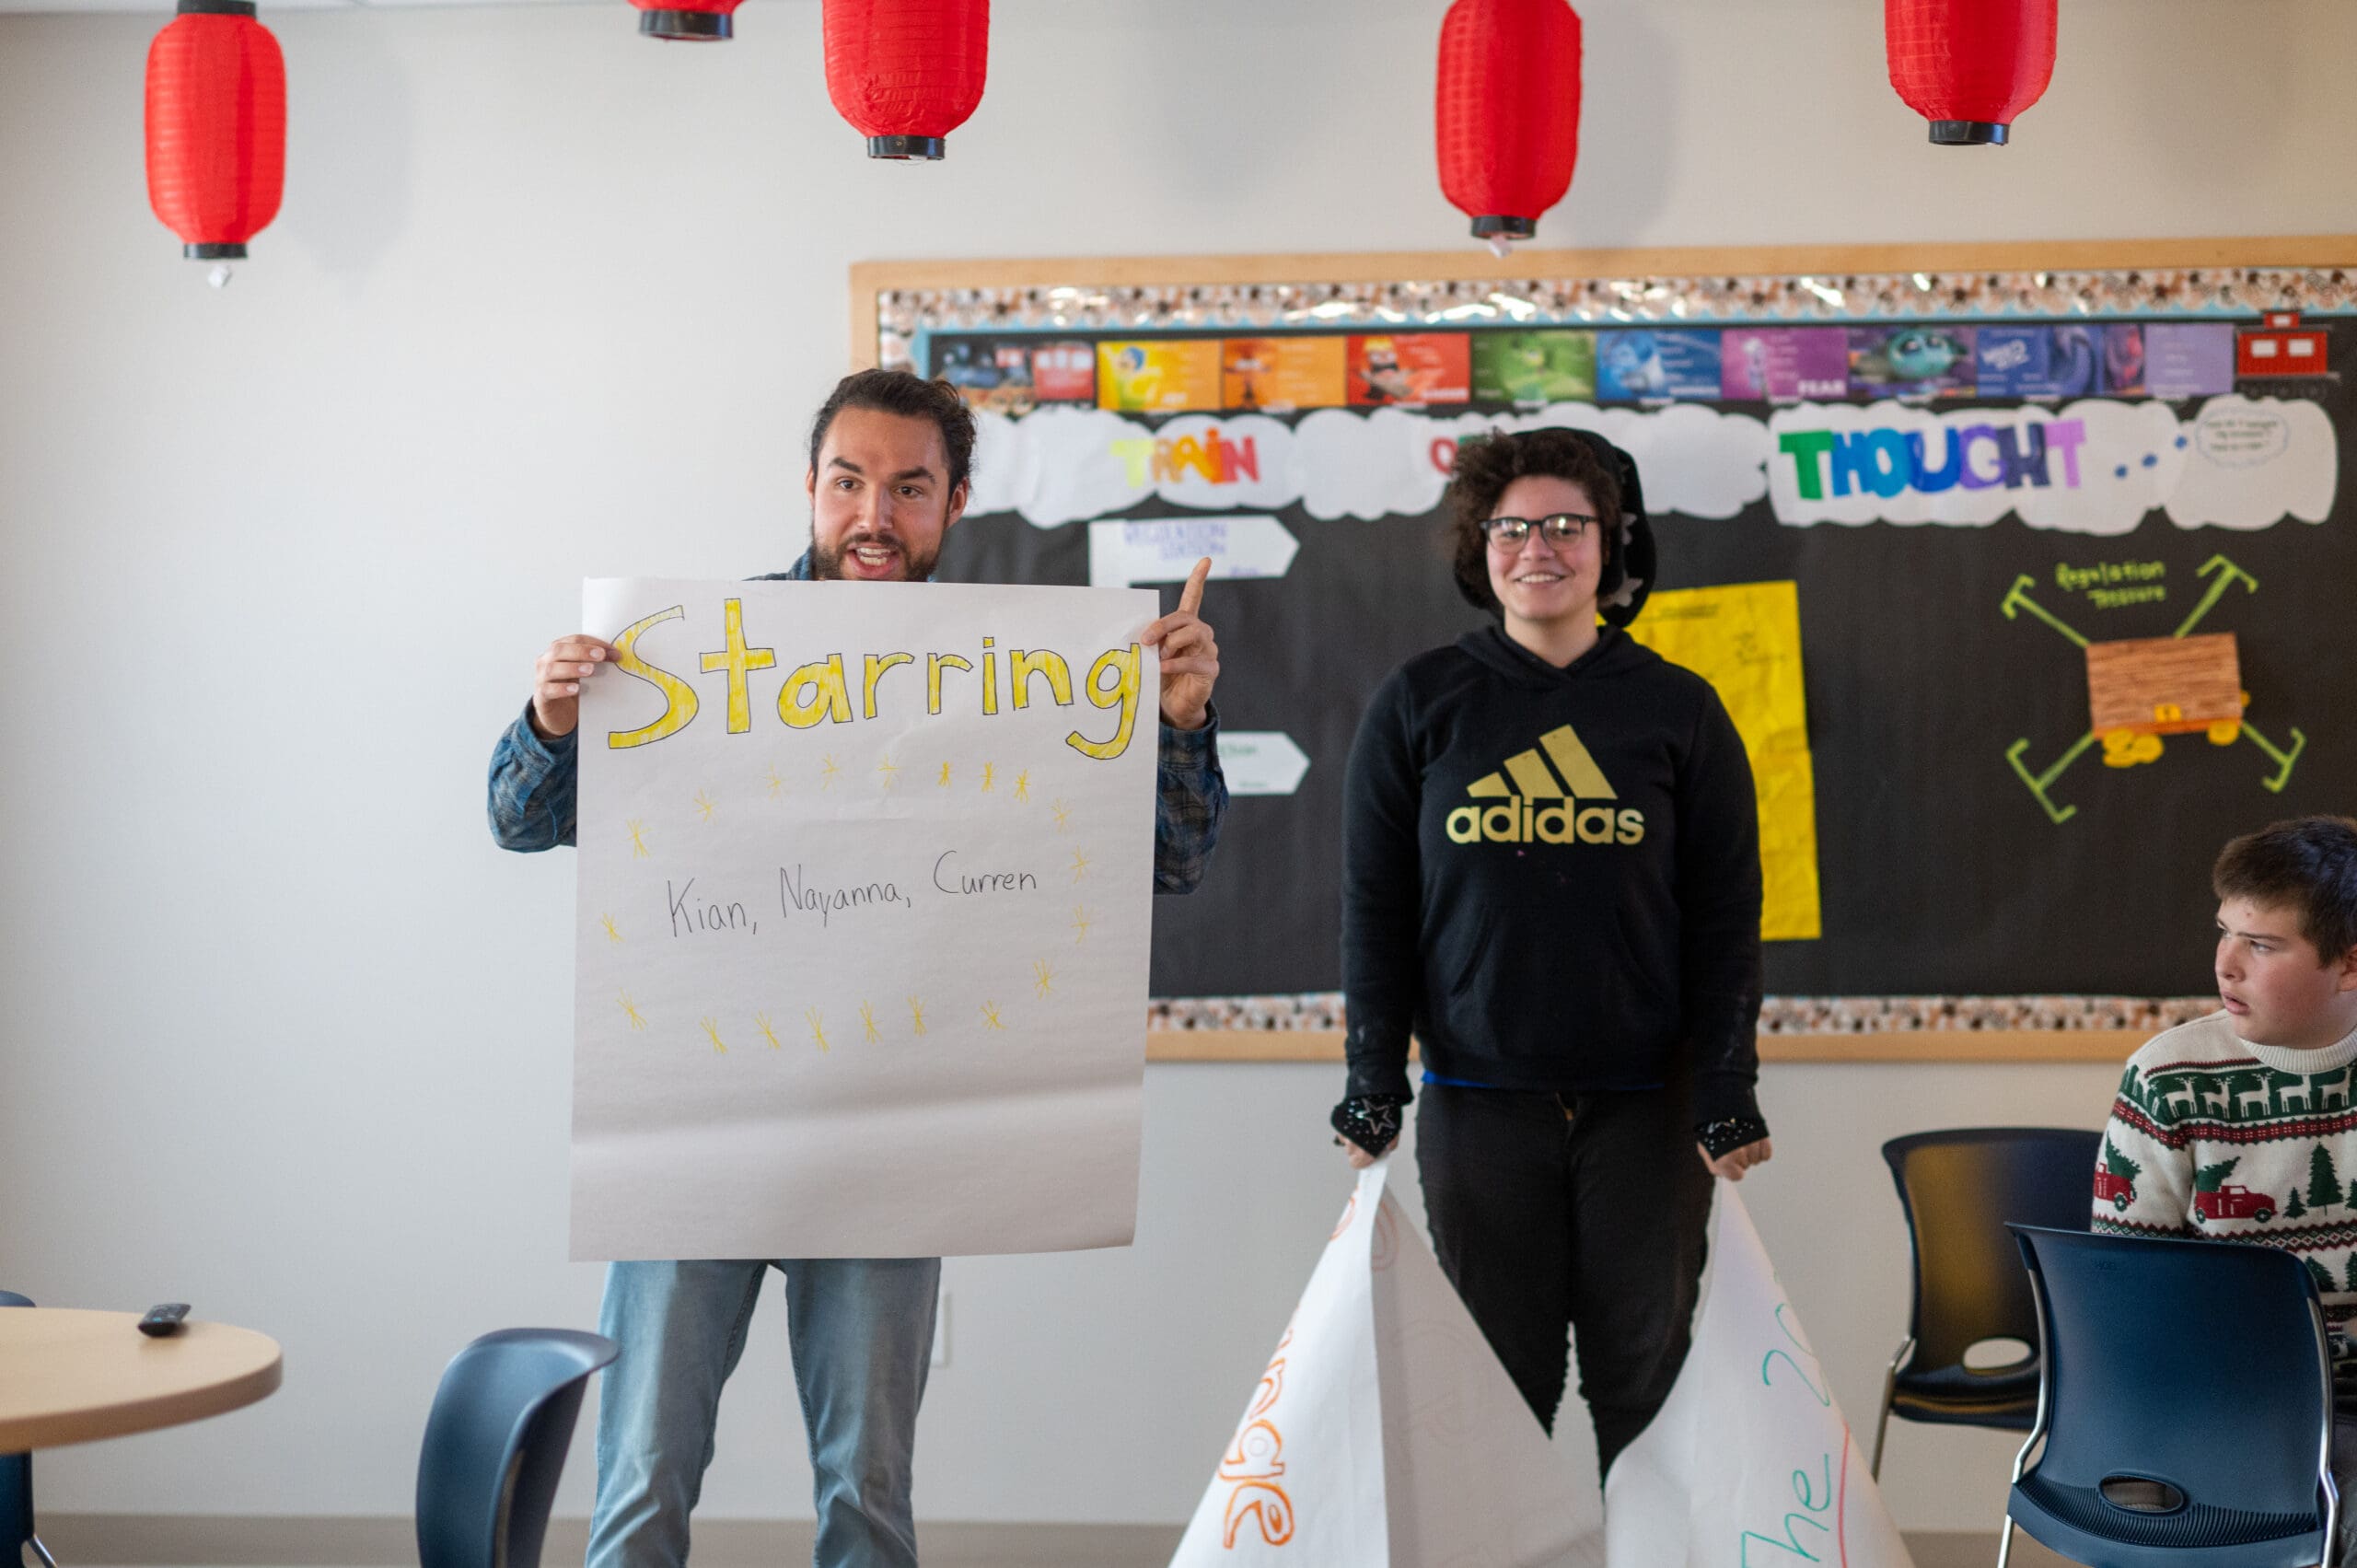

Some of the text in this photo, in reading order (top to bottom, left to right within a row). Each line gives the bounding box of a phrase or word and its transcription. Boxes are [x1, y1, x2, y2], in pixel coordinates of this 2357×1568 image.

[1779, 419, 2085, 500] THOUGHT
[608, 598, 1142, 761] Starring
[1446, 795, 1644, 845] adidas
[667, 849, 1038, 937] Kian, Nayanna, Curren
